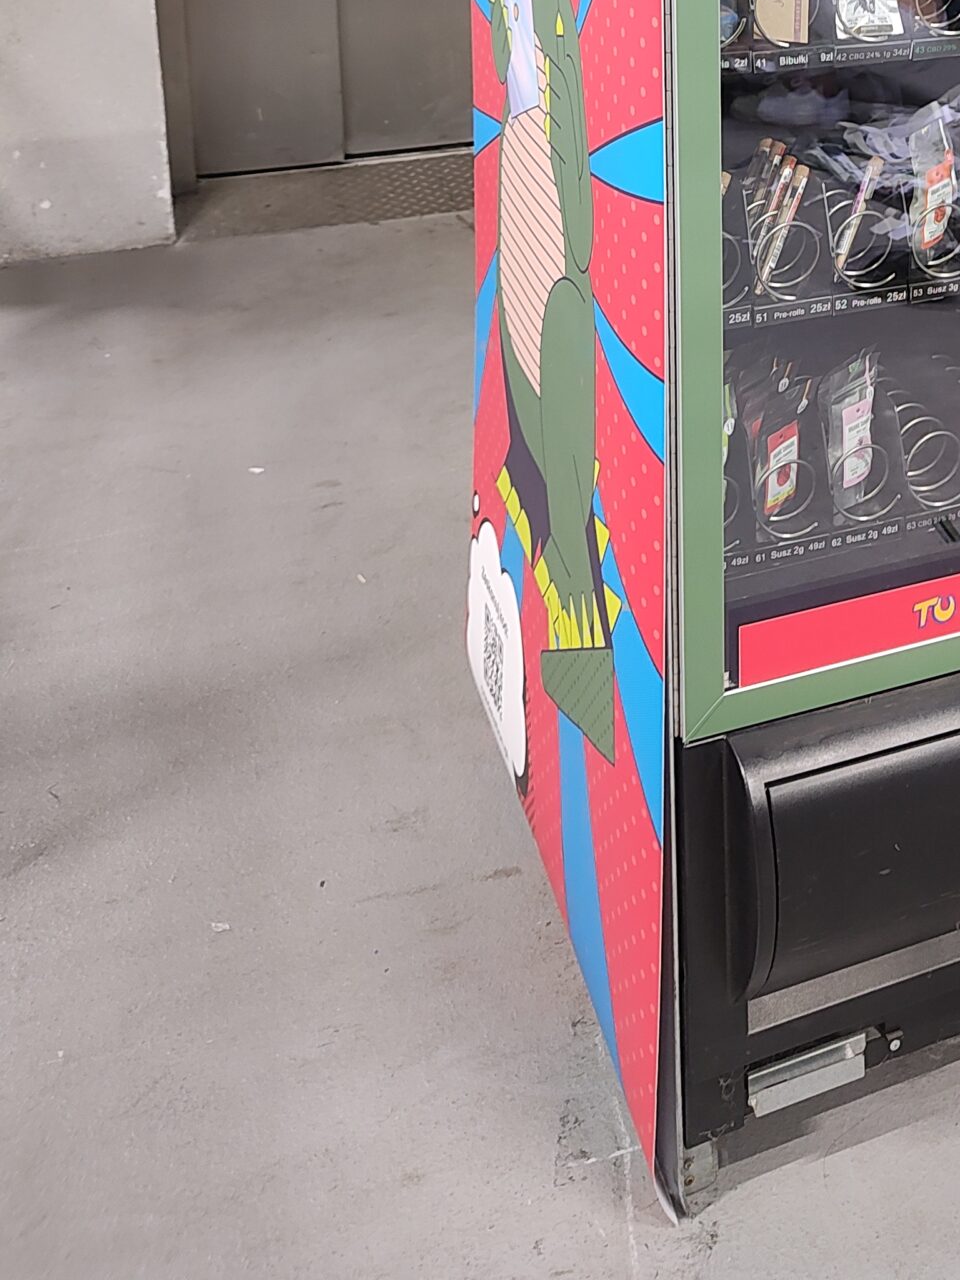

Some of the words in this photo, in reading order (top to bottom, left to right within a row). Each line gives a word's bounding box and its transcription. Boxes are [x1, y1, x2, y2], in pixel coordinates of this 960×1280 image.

[836, 52, 846, 61] 42
[893, 47, 910, 57] 34zł
[915, 45, 925, 54] 43
[755, 58, 766, 68] 41
[948, 282, 958, 292] 3g
[835, 299, 848, 310] 52
[887, 291, 907, 302] 25zł
[728, 312, 750, 324] 25zł
[755, 313, 767, 323] 51
[810, 303, 831, 314] 25zł
[906, 521, 916, 530] 63
[831, 537, 842, 547] 62
[868, 530, 878, 540] 2g
[881, 525, 898, 535] 49zł
[755, 552, 766, 563] 61
[771, 548, 792, 560] Susz
[793, 545, 804, 556] 2g
[731, 556, 749, 567] 49zł
[913, 595, 956, 628] TU
